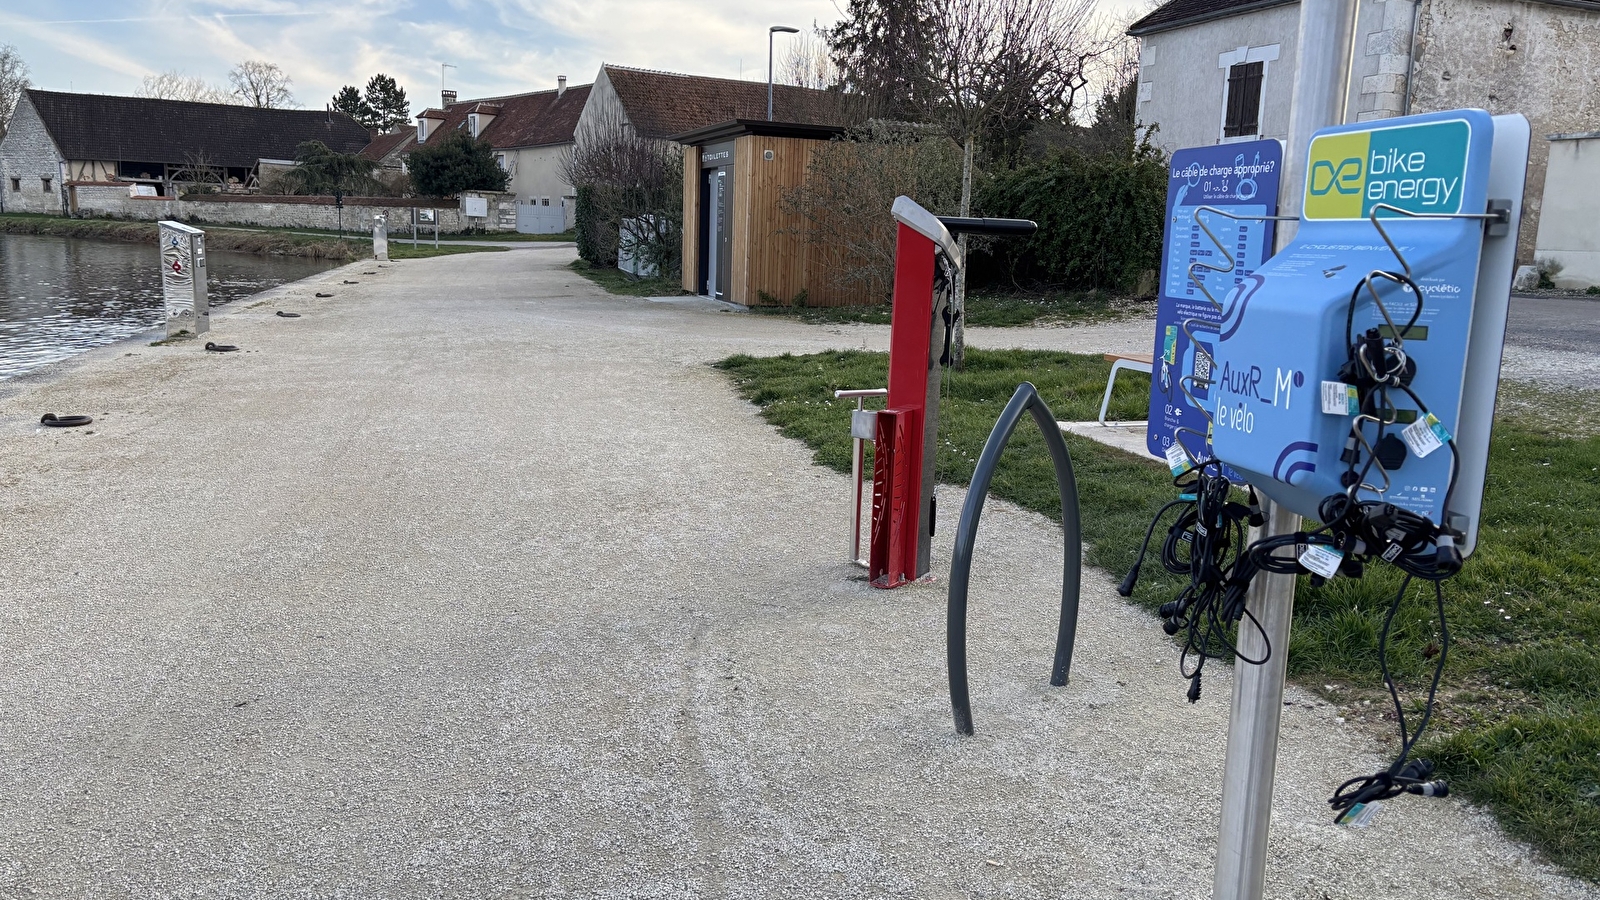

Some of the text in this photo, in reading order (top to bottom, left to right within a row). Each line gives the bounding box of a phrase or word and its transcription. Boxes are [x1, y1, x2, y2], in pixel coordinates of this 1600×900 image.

[1172, 160, 1276, 179] Le câble de charge approprié?
[1370, 148, 1426, 175] bike
[1203, 181, 1212, 192] 01
[1367, 176, 1459, 205] energy
[1164, 404, 1173, 416] 02
[1216, 396, 1254, 434] le vélo
[1162, 436, 1170, 447] 03
